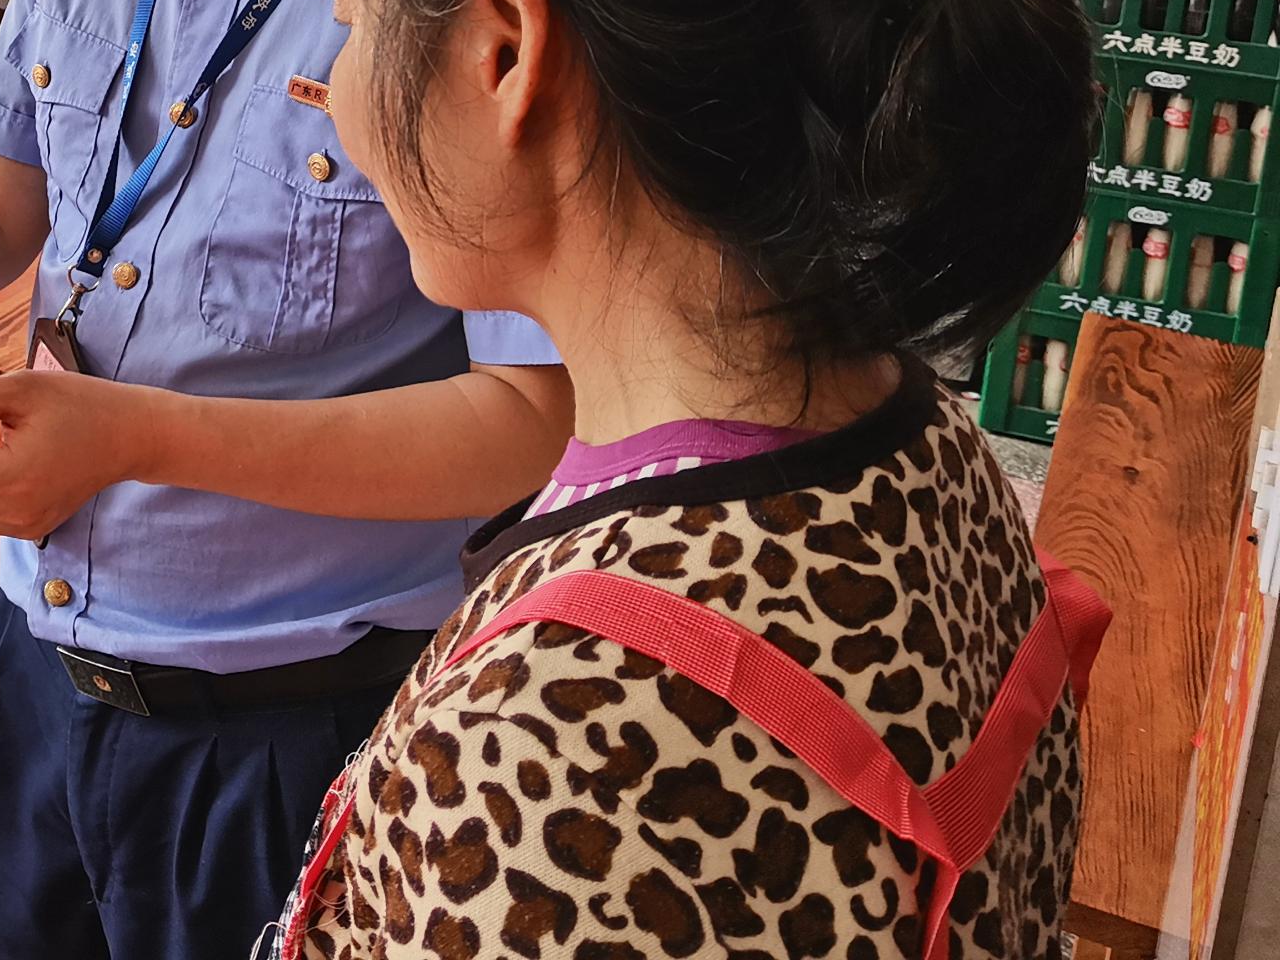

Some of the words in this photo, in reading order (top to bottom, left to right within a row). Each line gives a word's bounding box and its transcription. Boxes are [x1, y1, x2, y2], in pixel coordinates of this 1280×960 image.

[1102, 30, 1240, 67] 六点半豆奶
[1087, 162, 1213, 202] 六点半豆奶
[1059, 292, 1193, 334] 六点半豆奶
